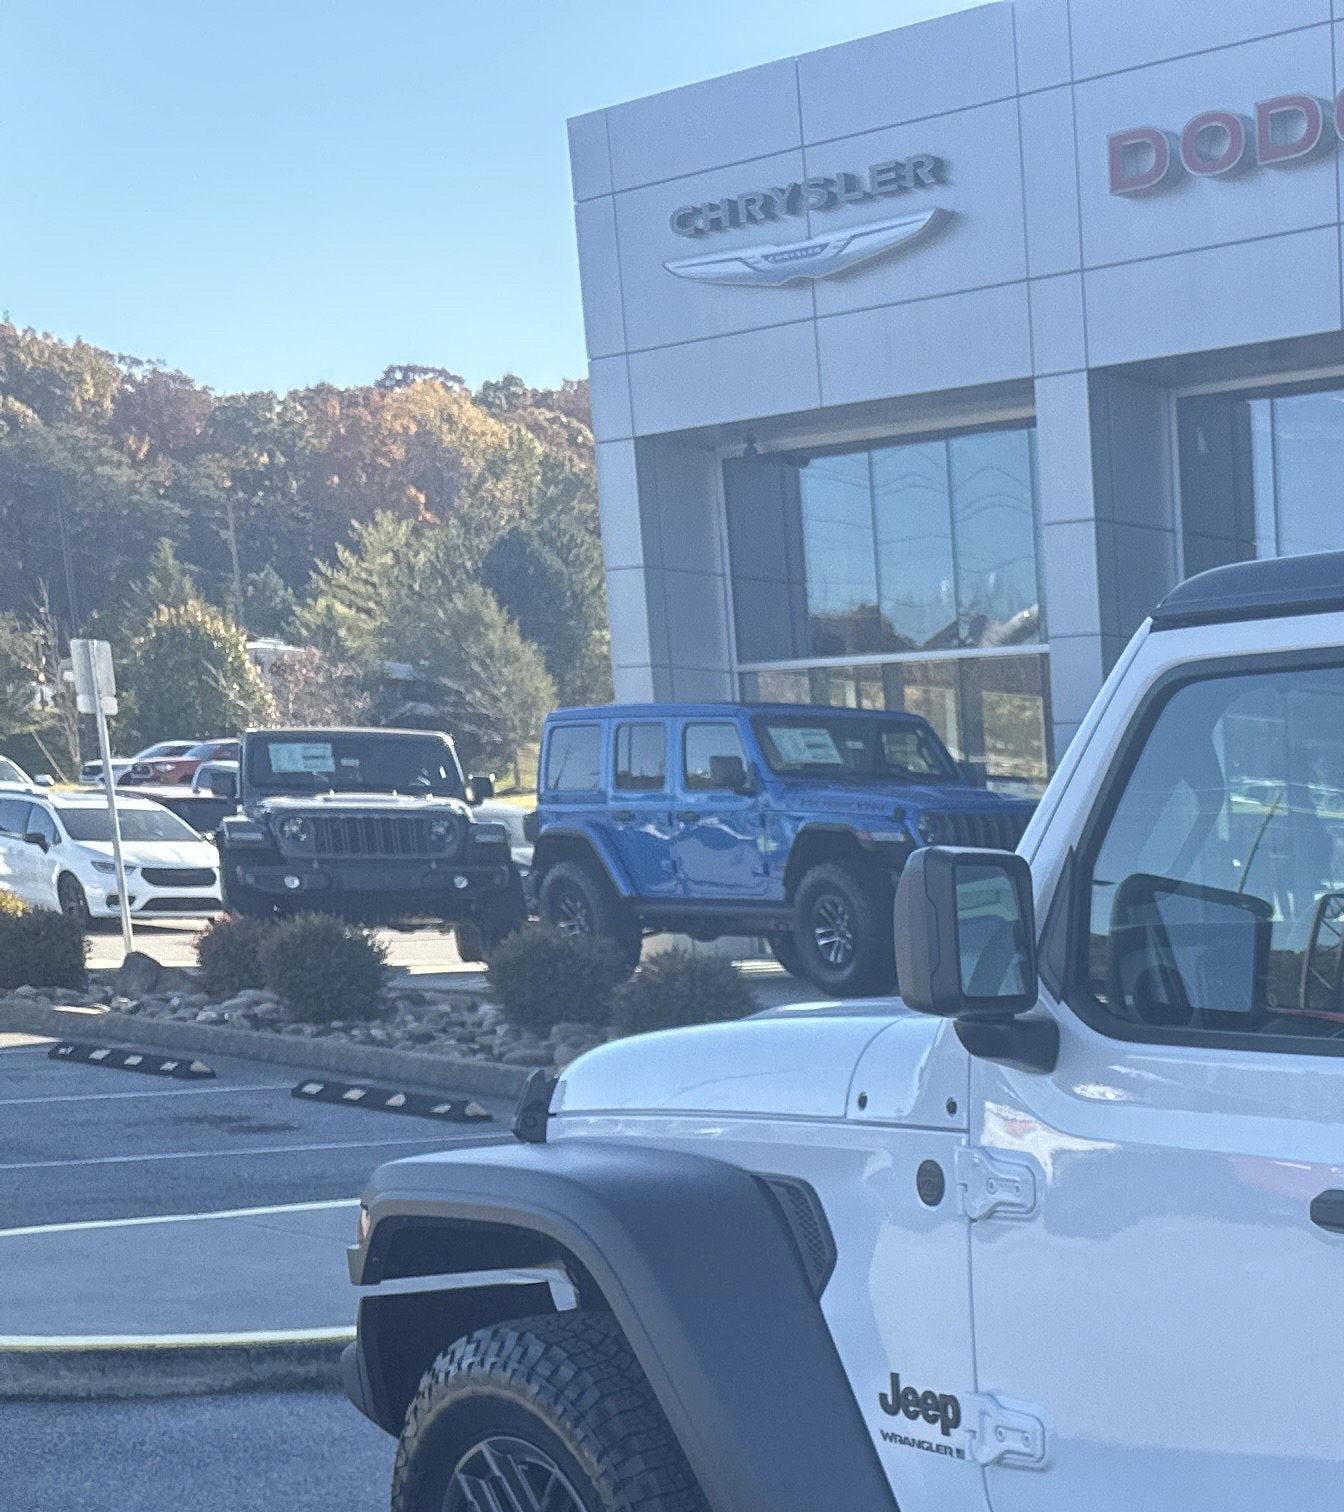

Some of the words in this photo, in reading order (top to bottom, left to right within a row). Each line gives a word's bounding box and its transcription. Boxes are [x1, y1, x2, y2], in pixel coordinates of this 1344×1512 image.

[669, 153, 942, 238] CHRYSLER
[879, 1372, 961, 1436] Jeep
[880, 1429, 954, 1458] WRANGLER
